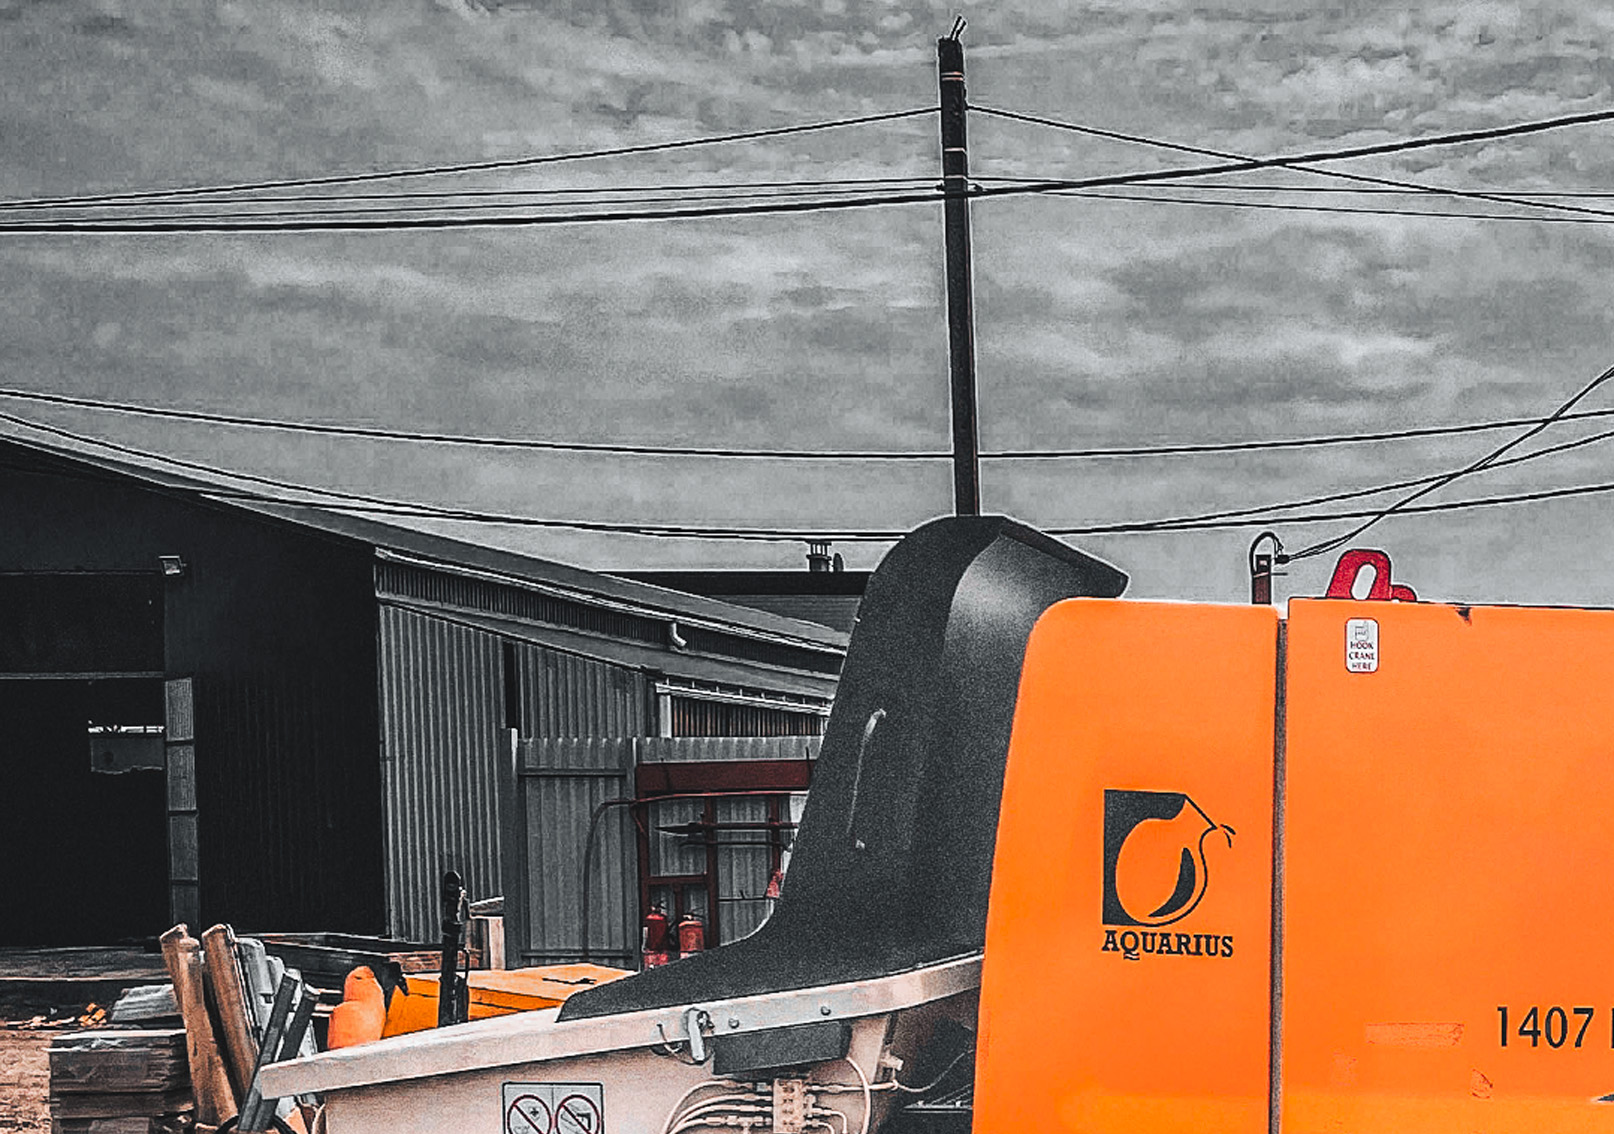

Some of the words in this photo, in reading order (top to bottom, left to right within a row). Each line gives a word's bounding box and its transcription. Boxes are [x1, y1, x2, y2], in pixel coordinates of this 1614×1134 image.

[1350, 641, 1374, 650] HOOK
[1349, 652, 1375, 660] CRANE
[1352, 662, 1372, 671] HERE
[1102, 930, 1234, 961] AQUARIUS
[1496, 1006, 1595, 1049] 1407
